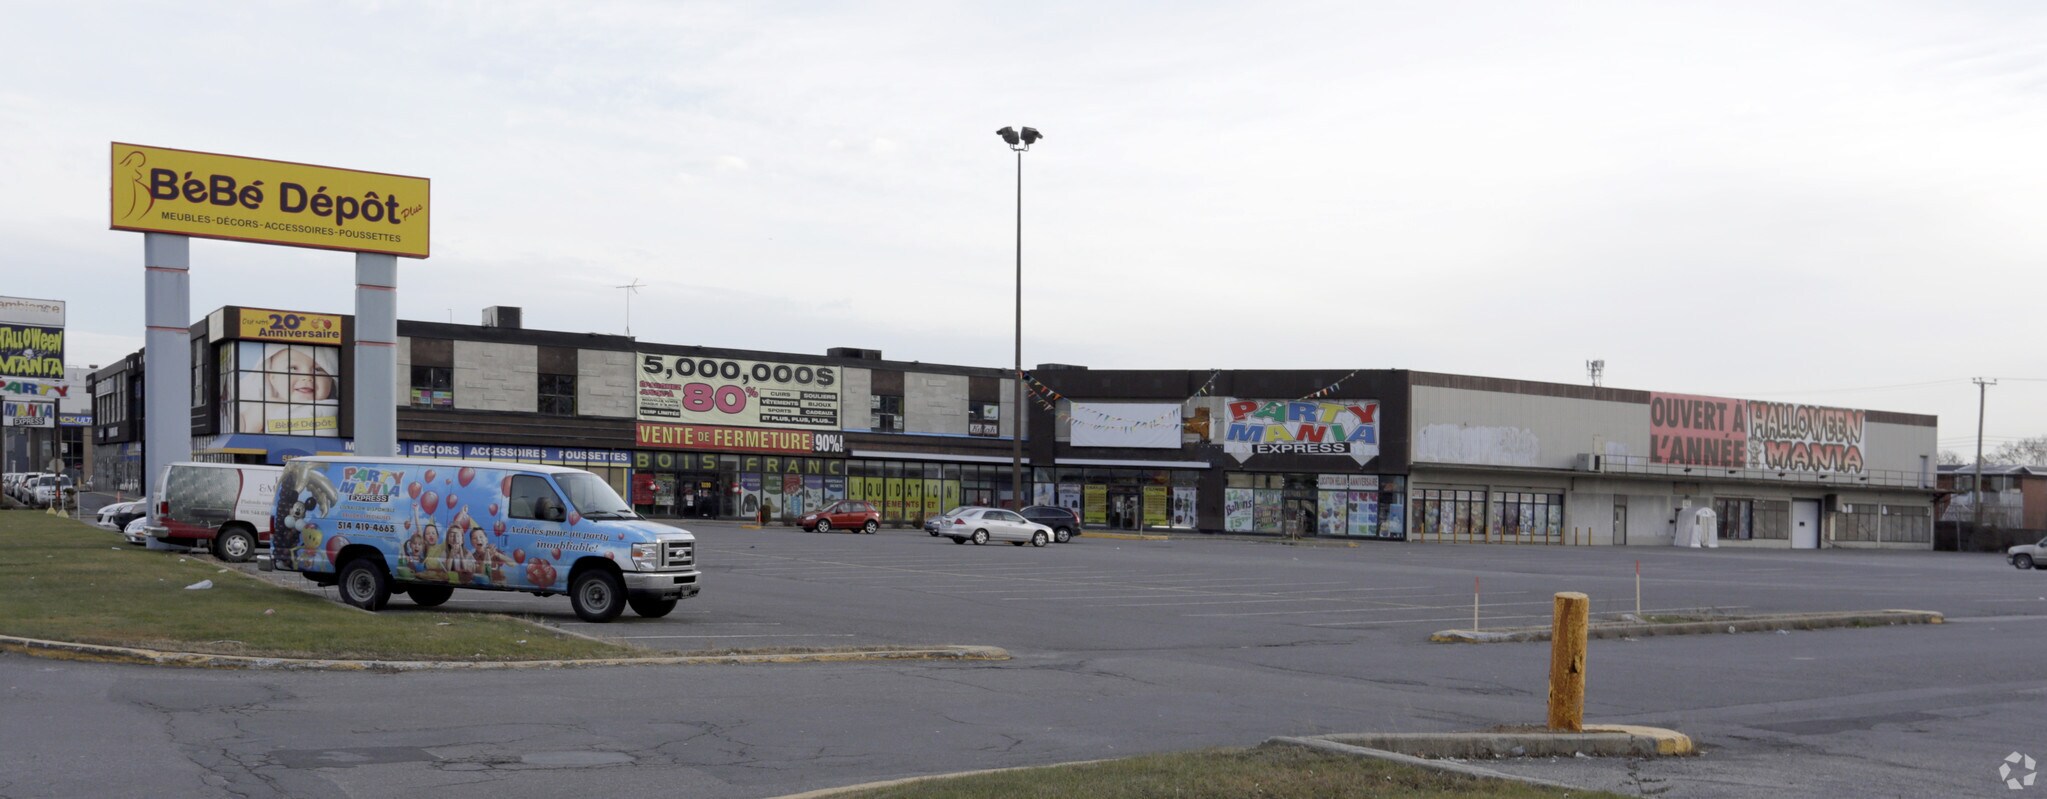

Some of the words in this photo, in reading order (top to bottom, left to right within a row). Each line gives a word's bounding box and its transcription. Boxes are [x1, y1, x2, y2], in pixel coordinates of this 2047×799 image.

[150, 168, 264, 209] BéBé
[280, 181, 401, 227] Dépôt
[258, 328, 340, 339] Anniversaire
[643, 355, 835, 388] 5,000,000$
[5, 402, 53, 419] MANIA
[1228, 401, 1378, 424] PARTY
[1651, 397, 1728, 432] OUVERT
[1733, 399, 1745, 433] À
[14, 417, 44, 425] EXPRESS
[1750, 400, 1865, 444] HALLOWEEN
[639, 425, 694, 445] VENTE
[697, 431, 709, 442] DE
[714, 429, 811, 451] FERMETURE
[815, 433, 844, 453] 90%!
[1226, 423, 1376, 444] MANIA
[470, 446, 547, 458] ACCESSOIRES
[558, 449, 628, 461] POUSSETTES
[1257, 443, 1346, 454] EXPRESS
[1652, 433, 1745, 467] L'ANNÉE
[1765, 439, 1864, 474] MANIA
[636, 454, 715, 470] BOIS
[746, 457, 840, 475] FRANC
[343, 466, 405, 485] PARTY
[339, 480, 401, 497] MANIA
[350, 494, 388, 502] EXPRESS
[338, 521, 352, 529] 514
[355, 522, 395, 533] 419-4665
[512, 526, 544, 535] Articles
[545, 529, 567, 537] pour
[582, 532, 609, 541] party
[536, 540, 599, 552] inoubliable!
